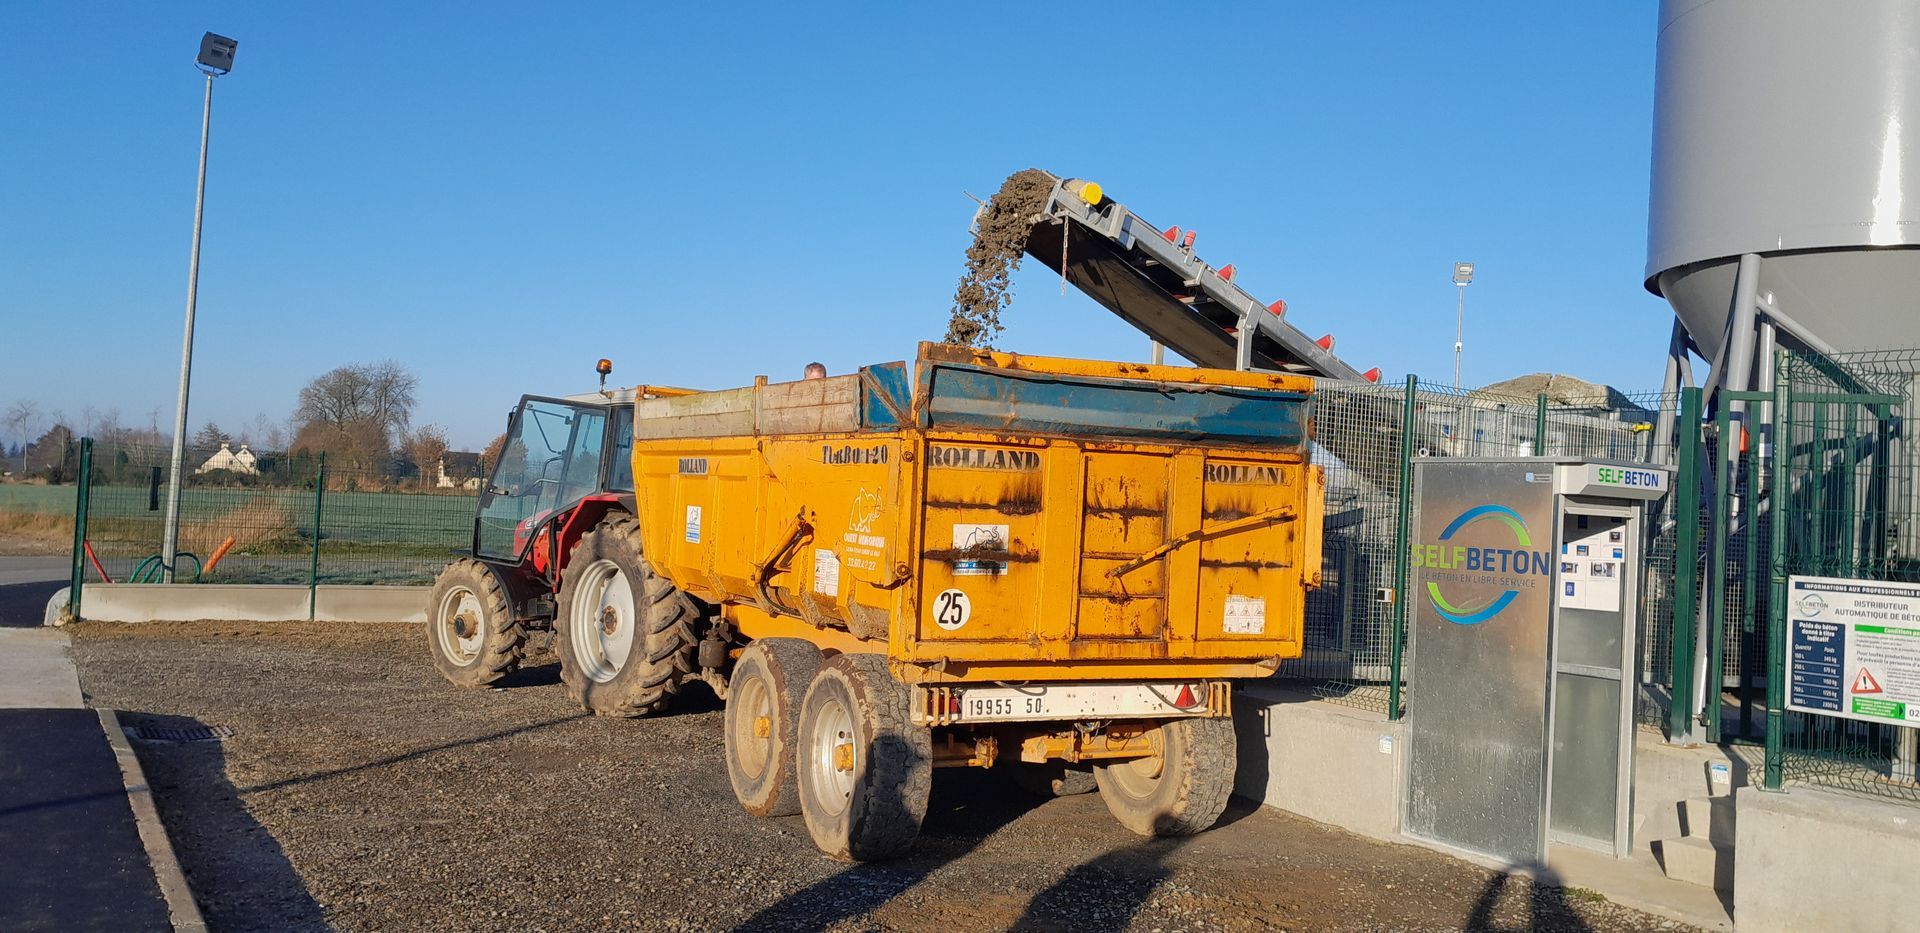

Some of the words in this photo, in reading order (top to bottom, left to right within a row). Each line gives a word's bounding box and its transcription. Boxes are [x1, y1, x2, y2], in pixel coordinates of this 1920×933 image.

[928, 446, 1040, 470] ROLLAND
[679, 458, 707, 473] ROLLAND
[1411, 544, 1550, 576] SELFBETON
[1460, 574, 1471, 583] EN
[1474, 576, 1497, 585] LIBRE
[1500, 578, 1536, 588] SERVICE
[1804, 583, 1847, 592] INFORMATIONS
[1862, 587, 1914, 596] PROFESSIONNELS
[938, 592, 963, 625] 25
[1854, 600, 1908, 611] DISTRIBUTEUR
[1835, 608, 1888, 620] AUTOMATIQUE
[1890, 612, 1900, 620] DE
[970, 699, 1012, 716] 19955
[1026, 698, 1042, 714] 50
[1909, 709, 1920, 718] 02
